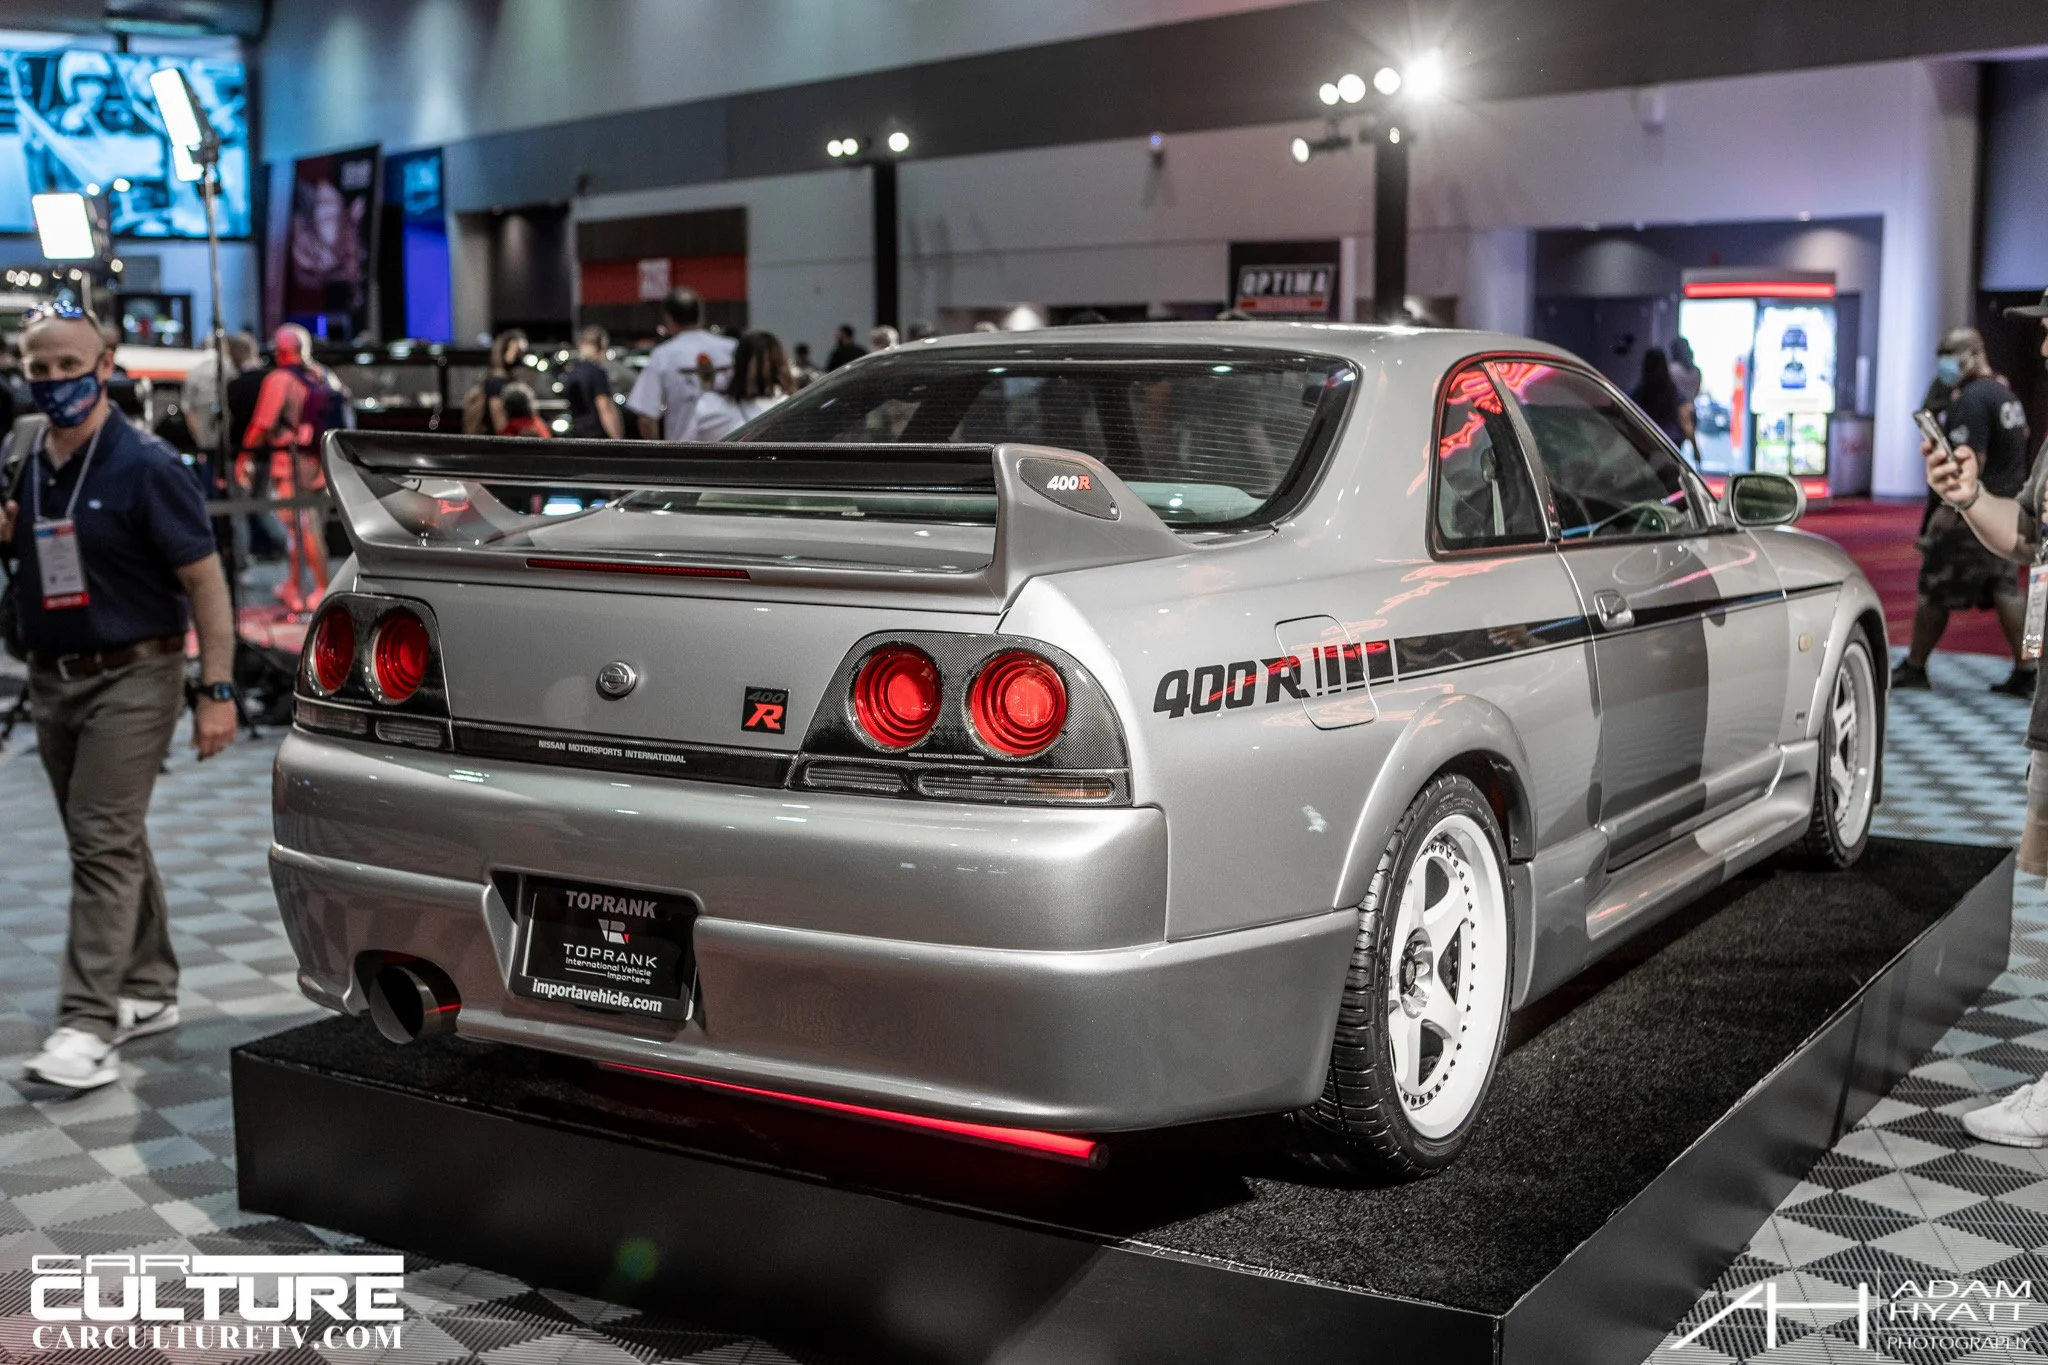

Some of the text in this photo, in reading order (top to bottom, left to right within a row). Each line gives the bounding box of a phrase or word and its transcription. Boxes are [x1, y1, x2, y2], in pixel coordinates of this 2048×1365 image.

[1046, 475, 1091, 490] 400R
[747, 691, 786, 704] 400
[1153, 655, 1311, 719] 400R
[744, 703, 783, 729] R
[538, 740, 686, 763] NISSAN MOTORSPORTS INTERNATIONAL
[565, 890, 657, 918] TOPRANK
[563, 943, 657, 968] TOPRANK
[565, 957, 652, 977] International Vehicle
[606, 971, 650, 984] Importers
[532, 979, 662, 1012] importavehicle.com
